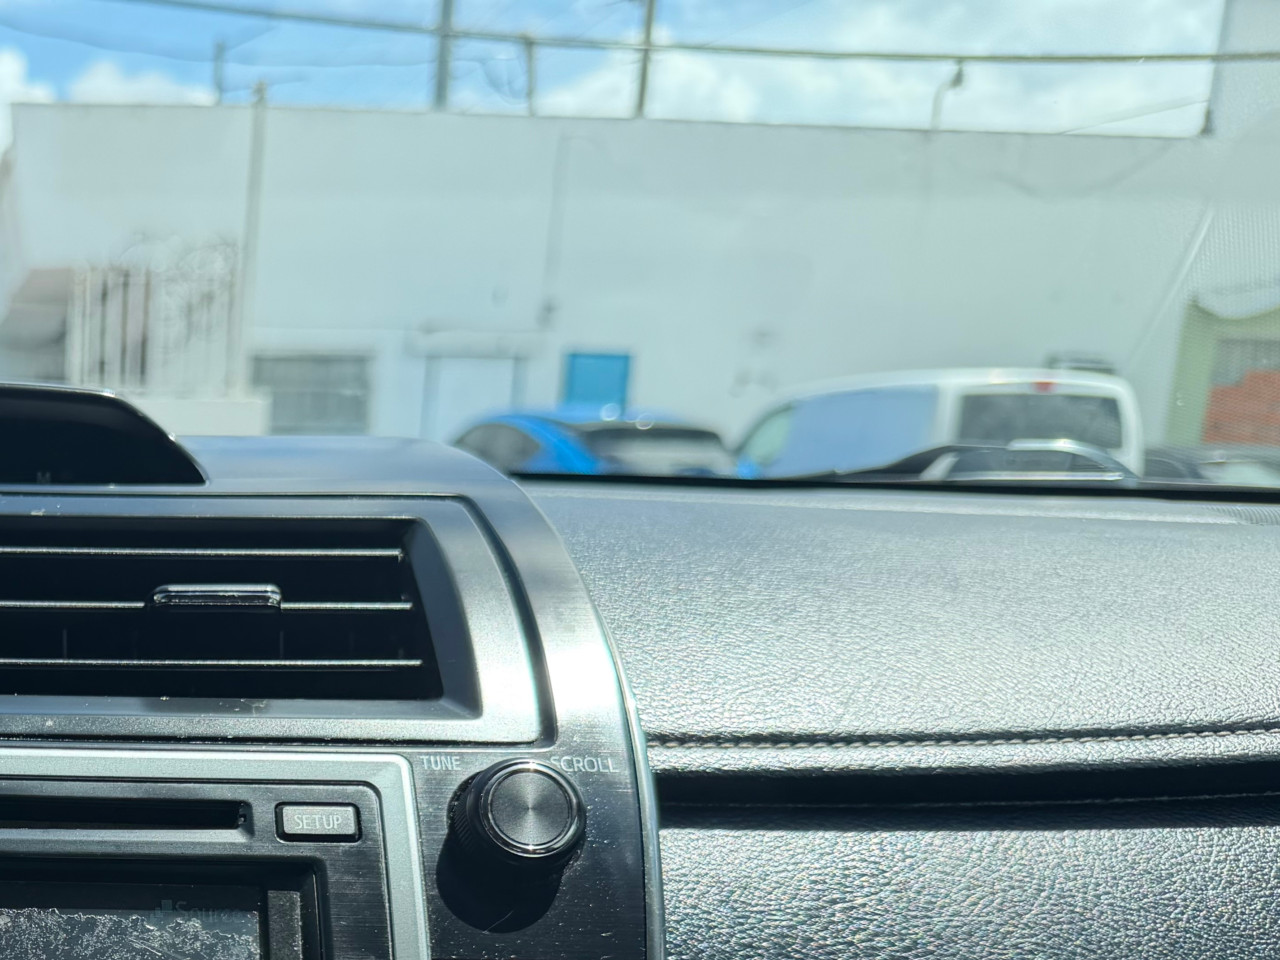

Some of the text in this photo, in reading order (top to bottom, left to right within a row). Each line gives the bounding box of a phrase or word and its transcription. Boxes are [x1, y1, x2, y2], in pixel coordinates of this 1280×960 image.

[420, 755, 461, 771] TUNE
[550, 755, 619, 773] SCROLL
[294, 814, 342, 830] SETUP
